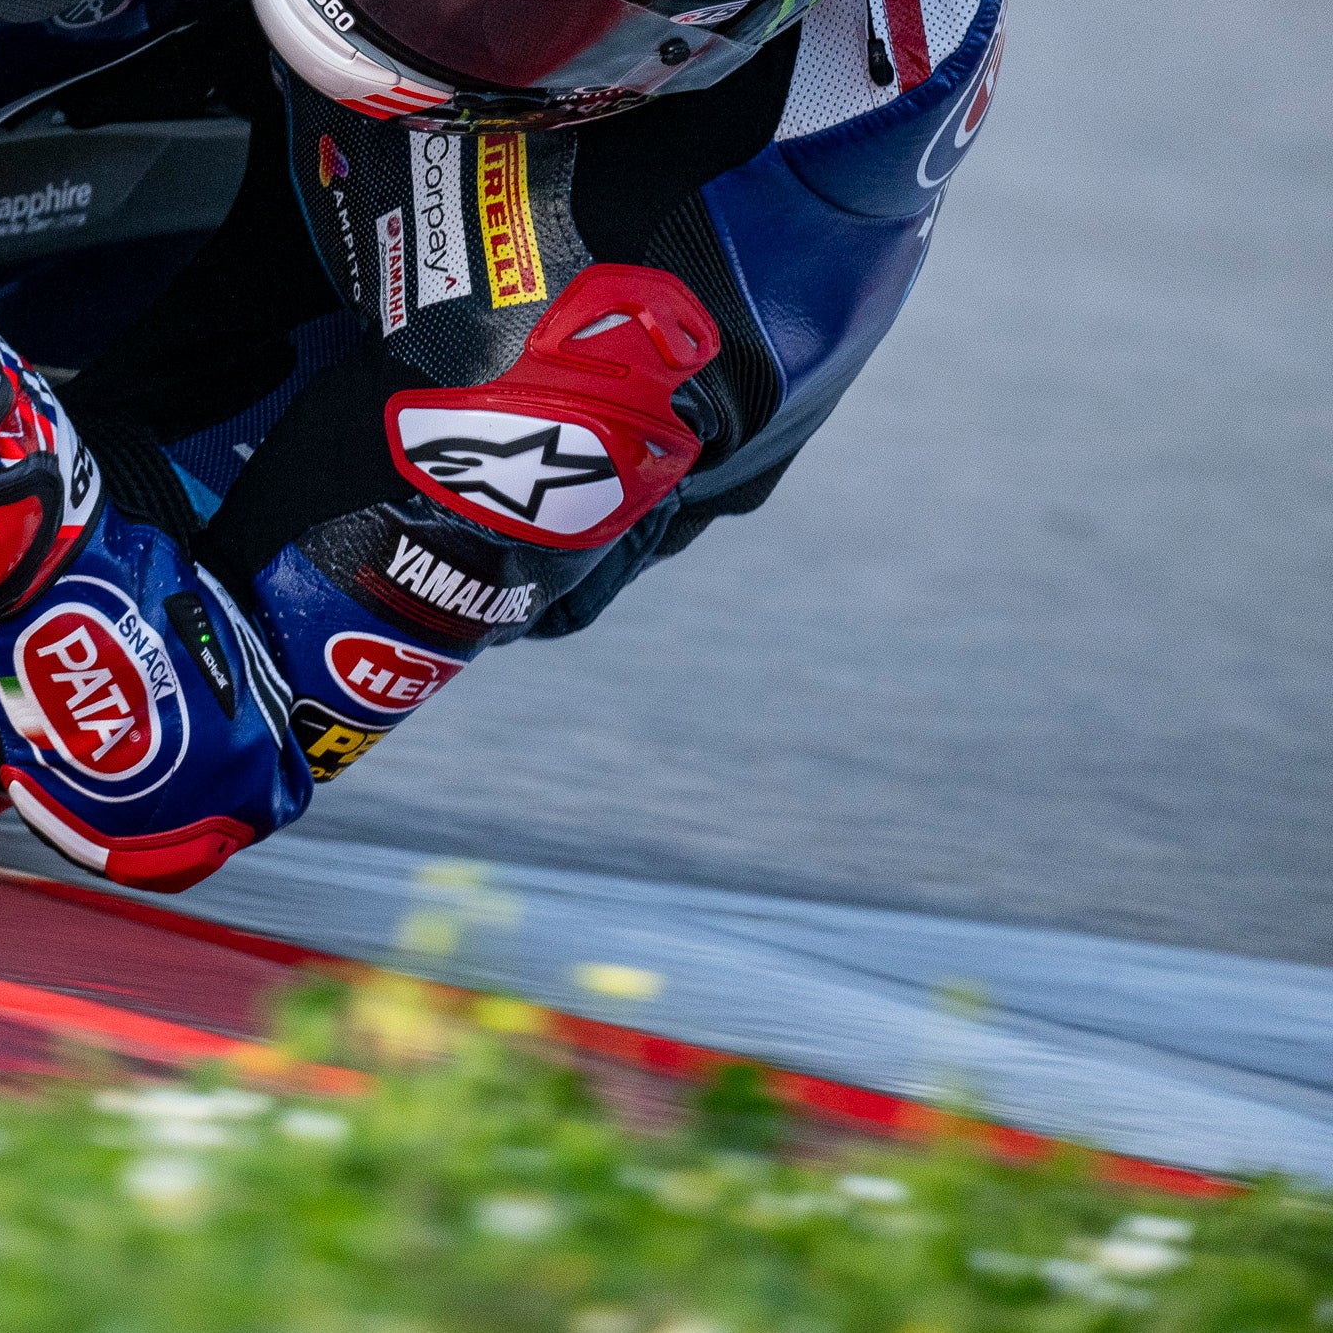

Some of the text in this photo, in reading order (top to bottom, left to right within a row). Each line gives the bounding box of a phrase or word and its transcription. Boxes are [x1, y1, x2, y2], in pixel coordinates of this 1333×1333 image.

[333, 190, 361, 302] AMPITO
[421, 135, 449, 273] Corpay
[388, 240, 405, 328] YAMAHA
[386, 534, 536, 623] YAMALUBE
[36, 625, 136, 762] PATA
[118, 616, 174, 699] SNACK
